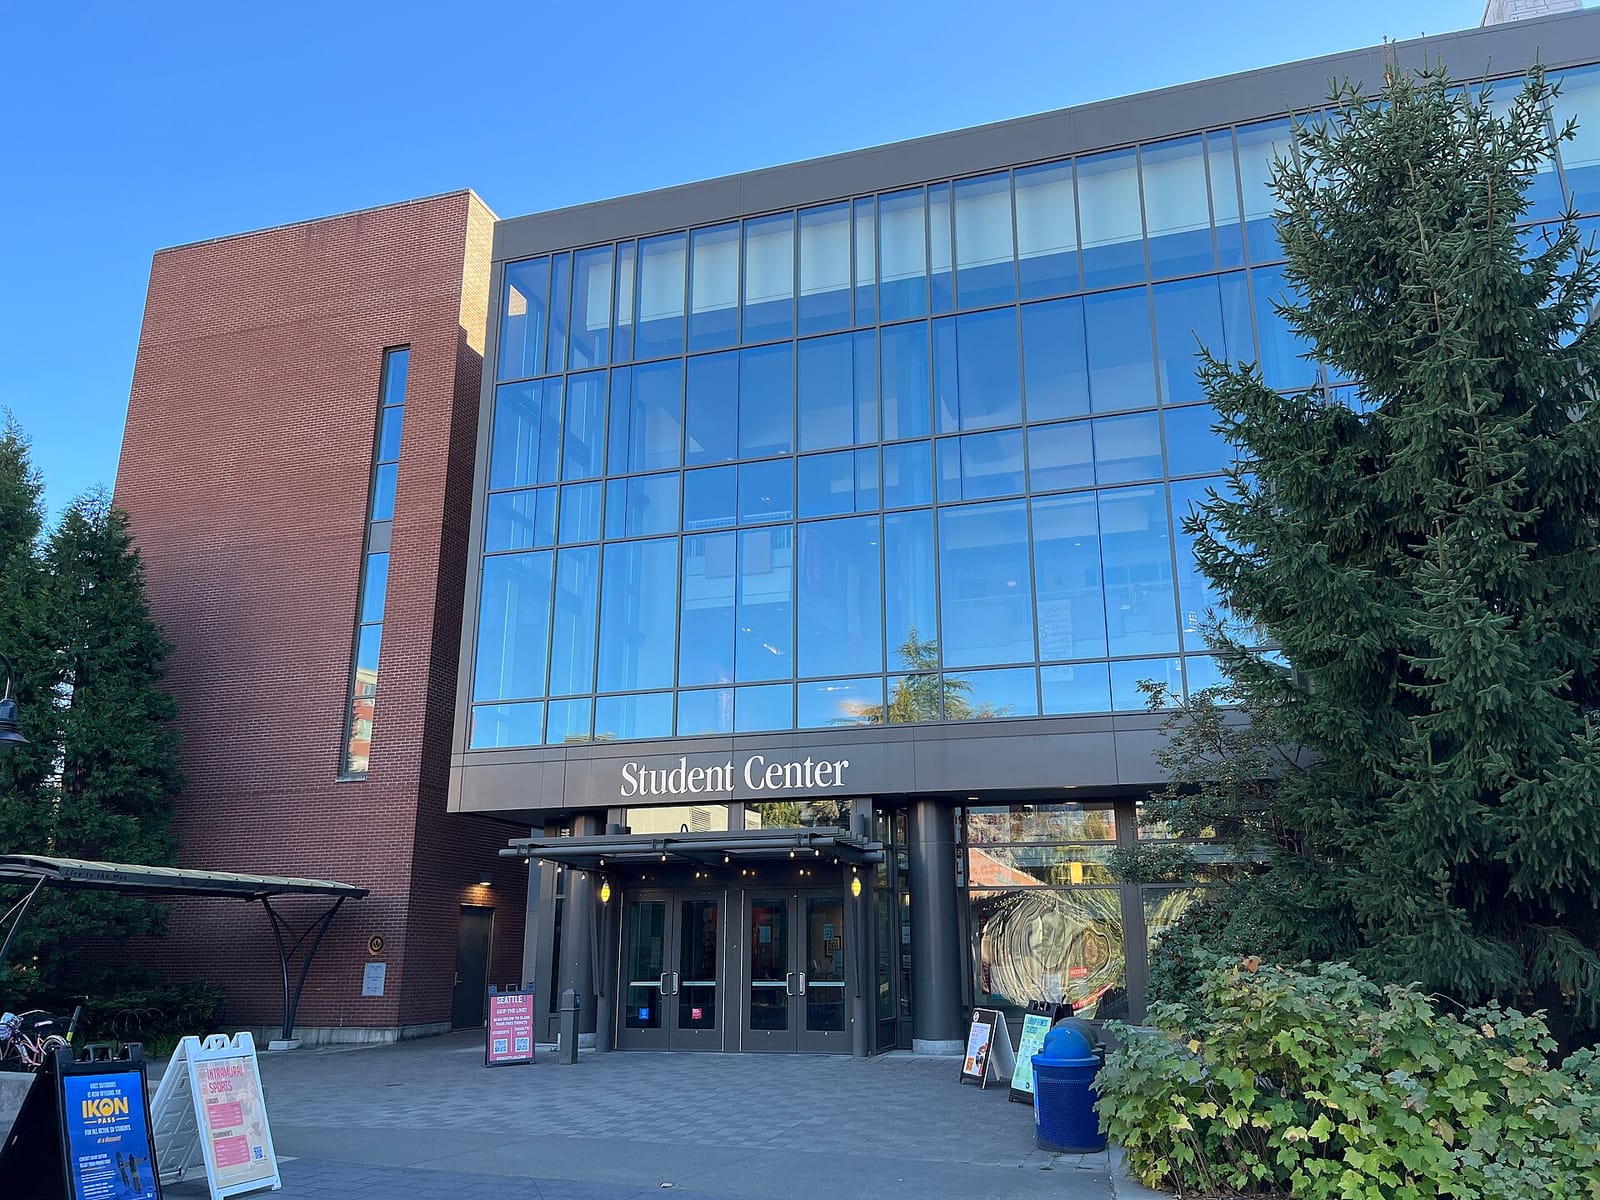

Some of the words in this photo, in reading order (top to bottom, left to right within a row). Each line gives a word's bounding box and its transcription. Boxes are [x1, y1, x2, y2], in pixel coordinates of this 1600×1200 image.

[620, 756, 735, 797] Student
[744, 755, 850, 791] Center
[496, 995, 523, 1004] SEATTLE
[207, 1065, 244, 1080] INTRAMURAL
[209, 1080, 233, 1094] SPORTS
[82, 1096, 129, 1118] IKON
